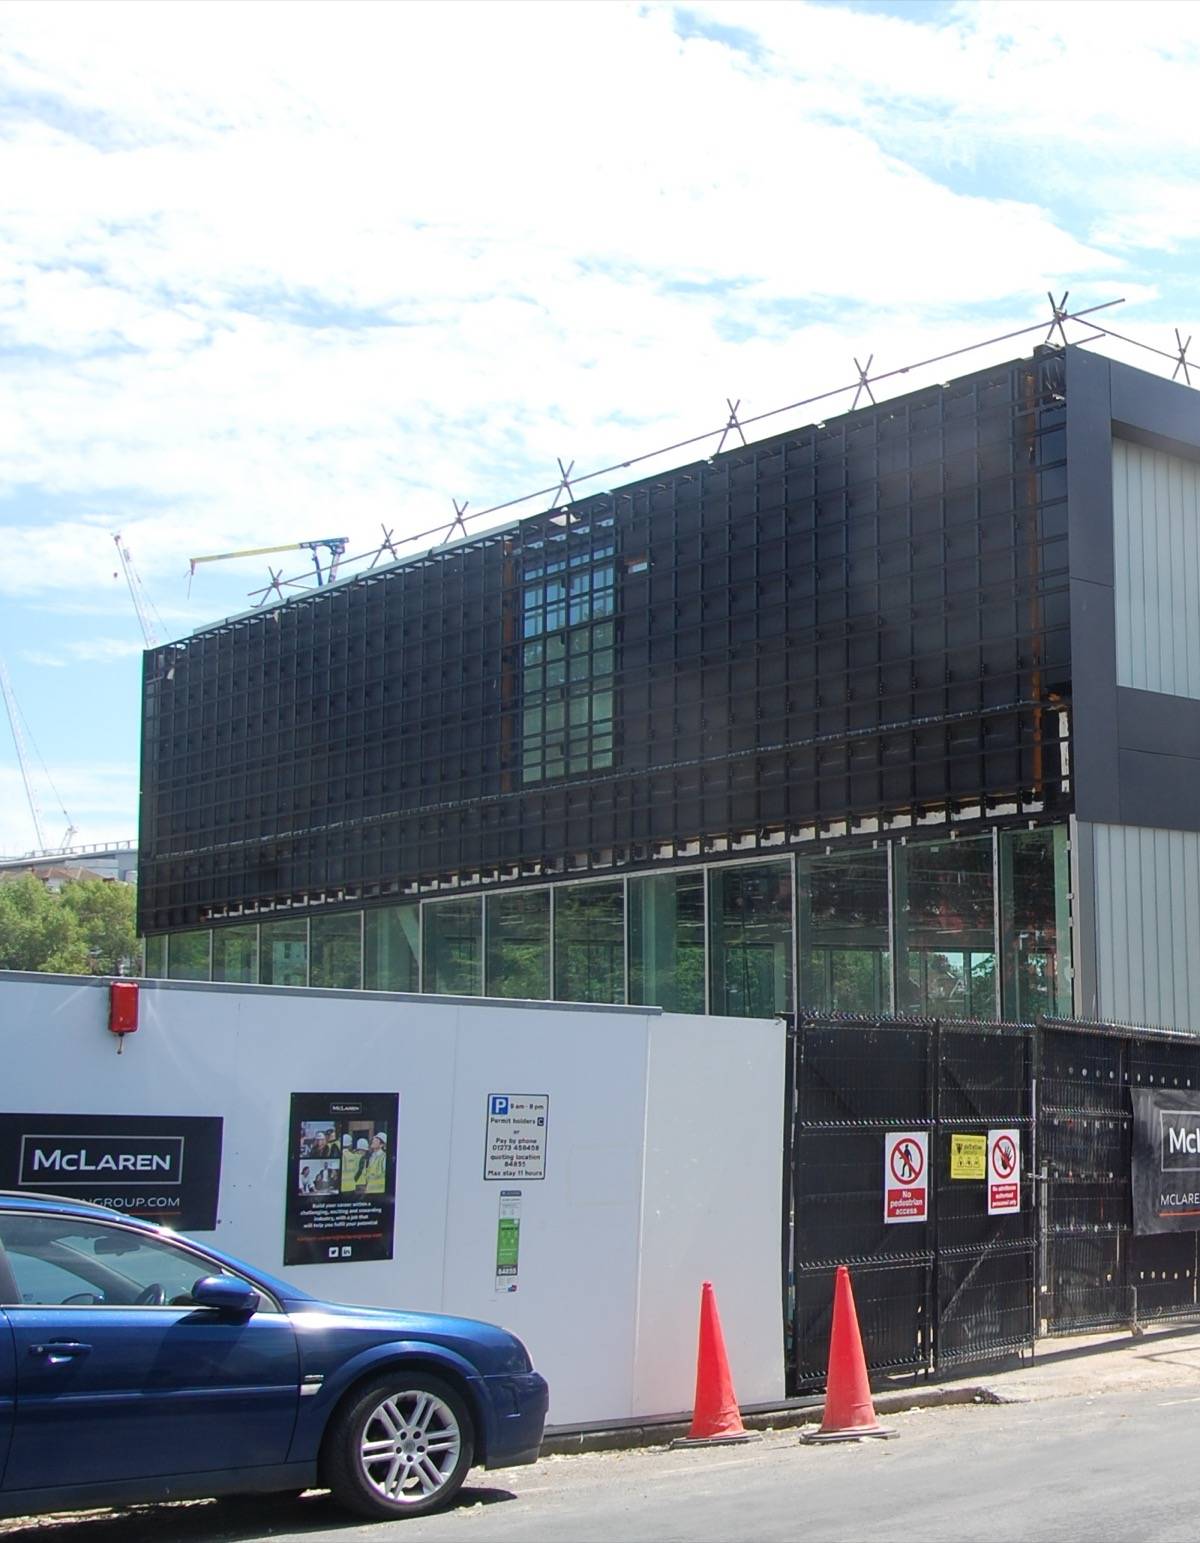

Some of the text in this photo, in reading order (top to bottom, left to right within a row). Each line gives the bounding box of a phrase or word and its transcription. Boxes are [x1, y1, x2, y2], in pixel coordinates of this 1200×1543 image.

[495, 1098, 507, 1113] P
[33, 1149, 171, 1171] McLAREN
[902, 1190, 912, 1198] No
[889, 1198, 923, 1208] pedestrian
